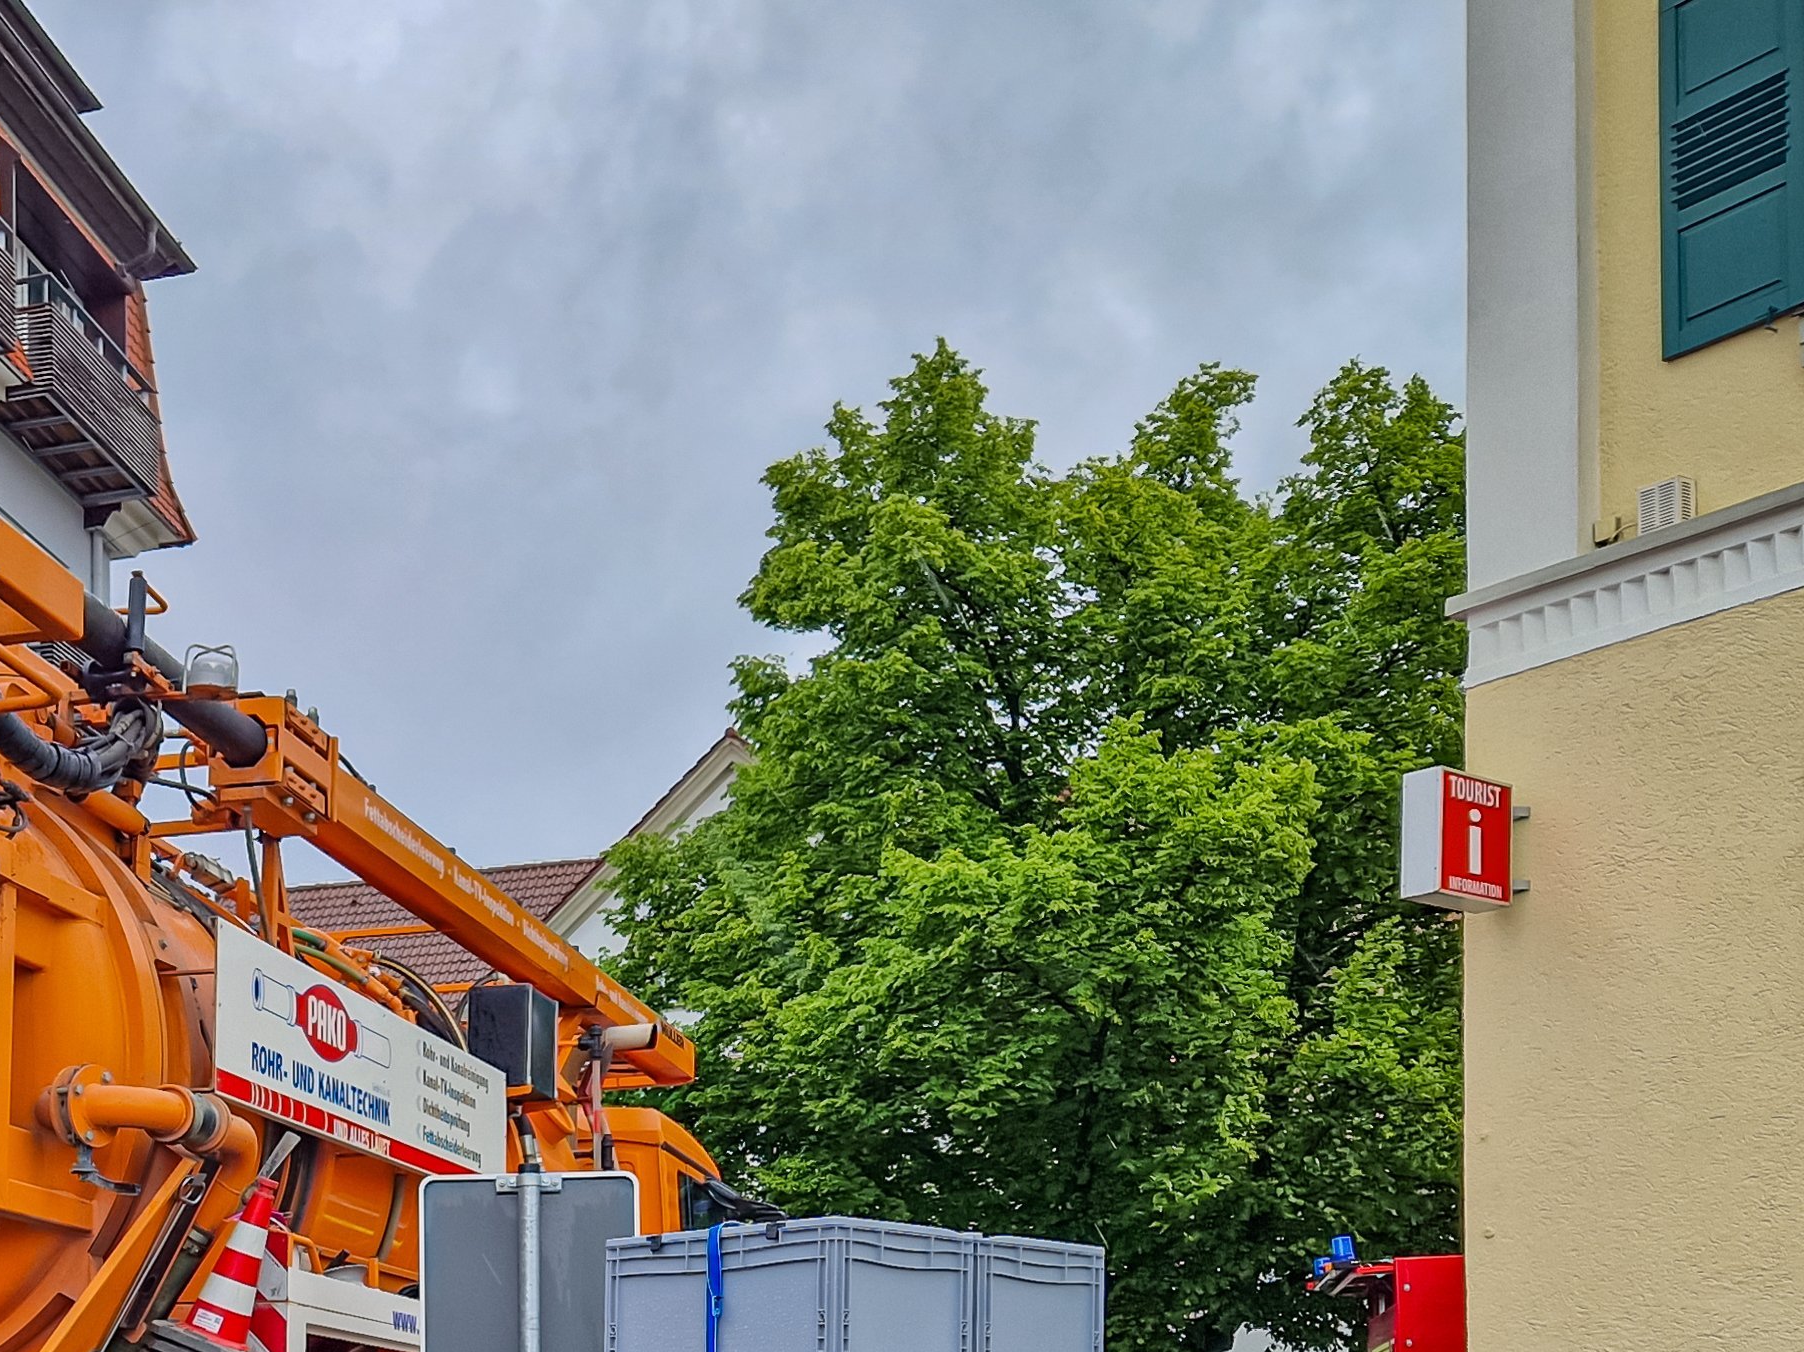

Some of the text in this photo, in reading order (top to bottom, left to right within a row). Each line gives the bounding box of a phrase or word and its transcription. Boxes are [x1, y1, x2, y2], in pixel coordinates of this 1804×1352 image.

[1449, 775, 1502, 808] TOURIST
[1449, 876, 1502, 899] INFORMATION
[307, 995, 347, 1052] PAKO
[439, 1053, 450, 1070] und
[251, 1041, 391, 1126] ROHR- UND KANALTECHNIK
